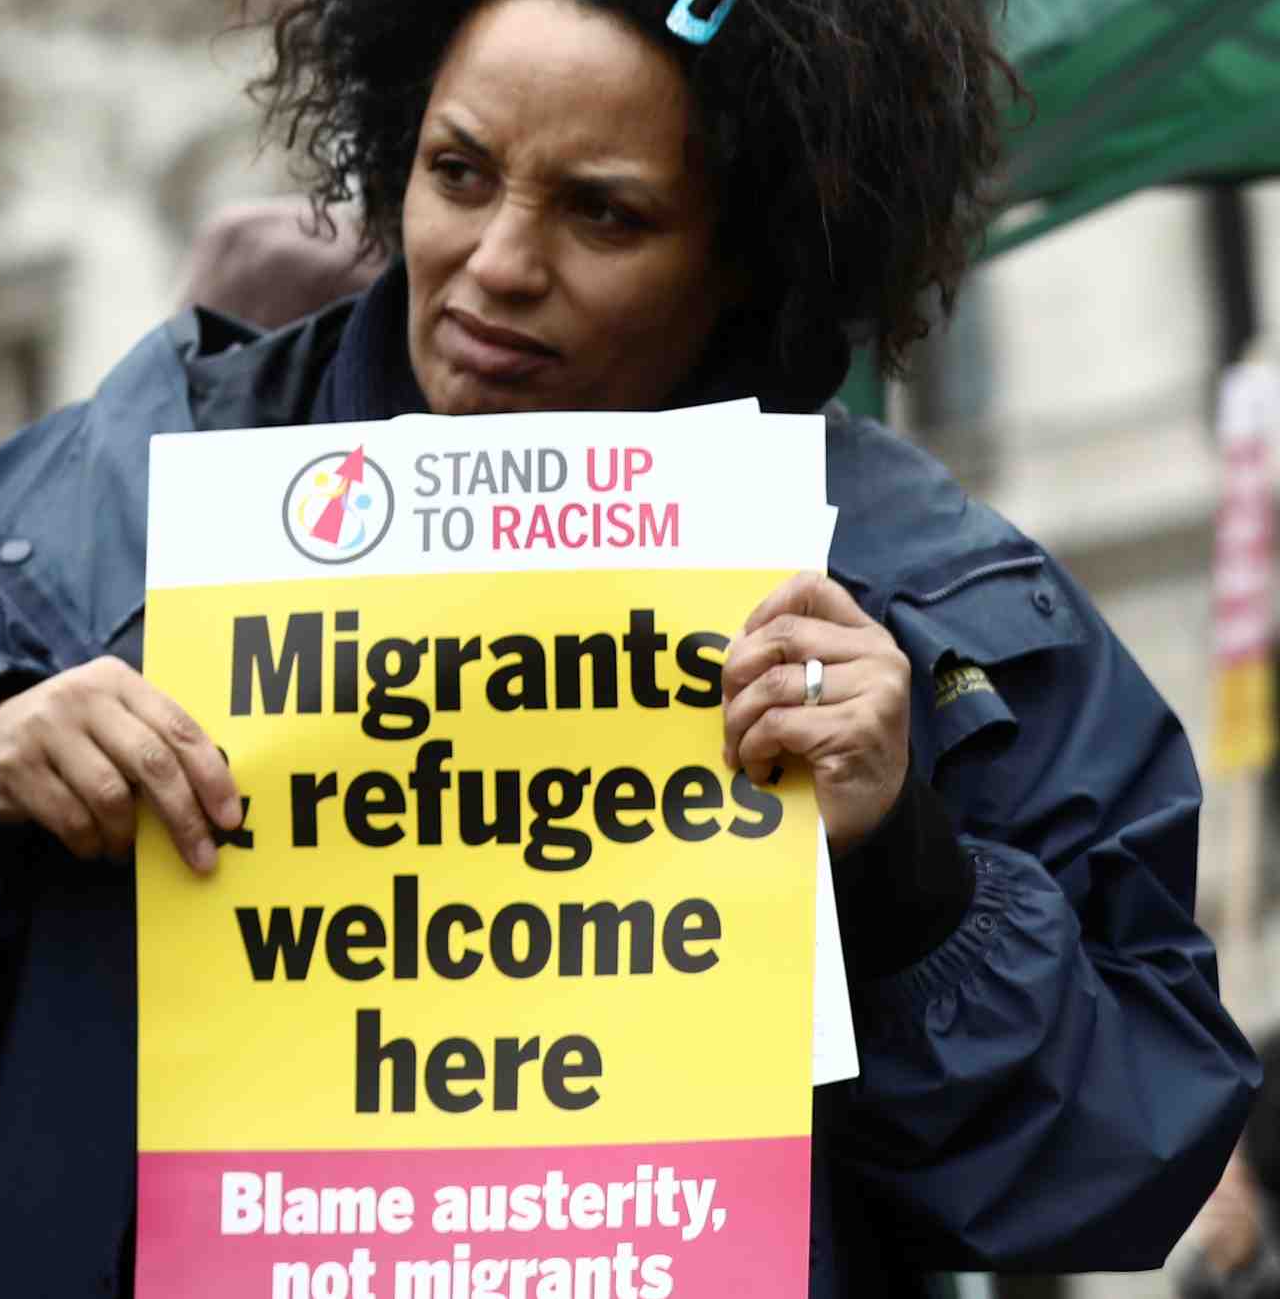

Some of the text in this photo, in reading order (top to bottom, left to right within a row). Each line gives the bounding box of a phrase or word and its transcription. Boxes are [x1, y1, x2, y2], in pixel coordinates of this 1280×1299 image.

[415, 447, 653, 497] STAND UP
[413, 503, 678, 552] TO RACISM
[230, 609, 730, 742] Migrants
[291, 740, 784, 872] refugees
[235, 875, 721, 981] welcome
[356, 1009, 602, 1113] here
[222, 1165, 726, 1240] Blame austerity,
[272, 1243, 673, 1299] not migrants
